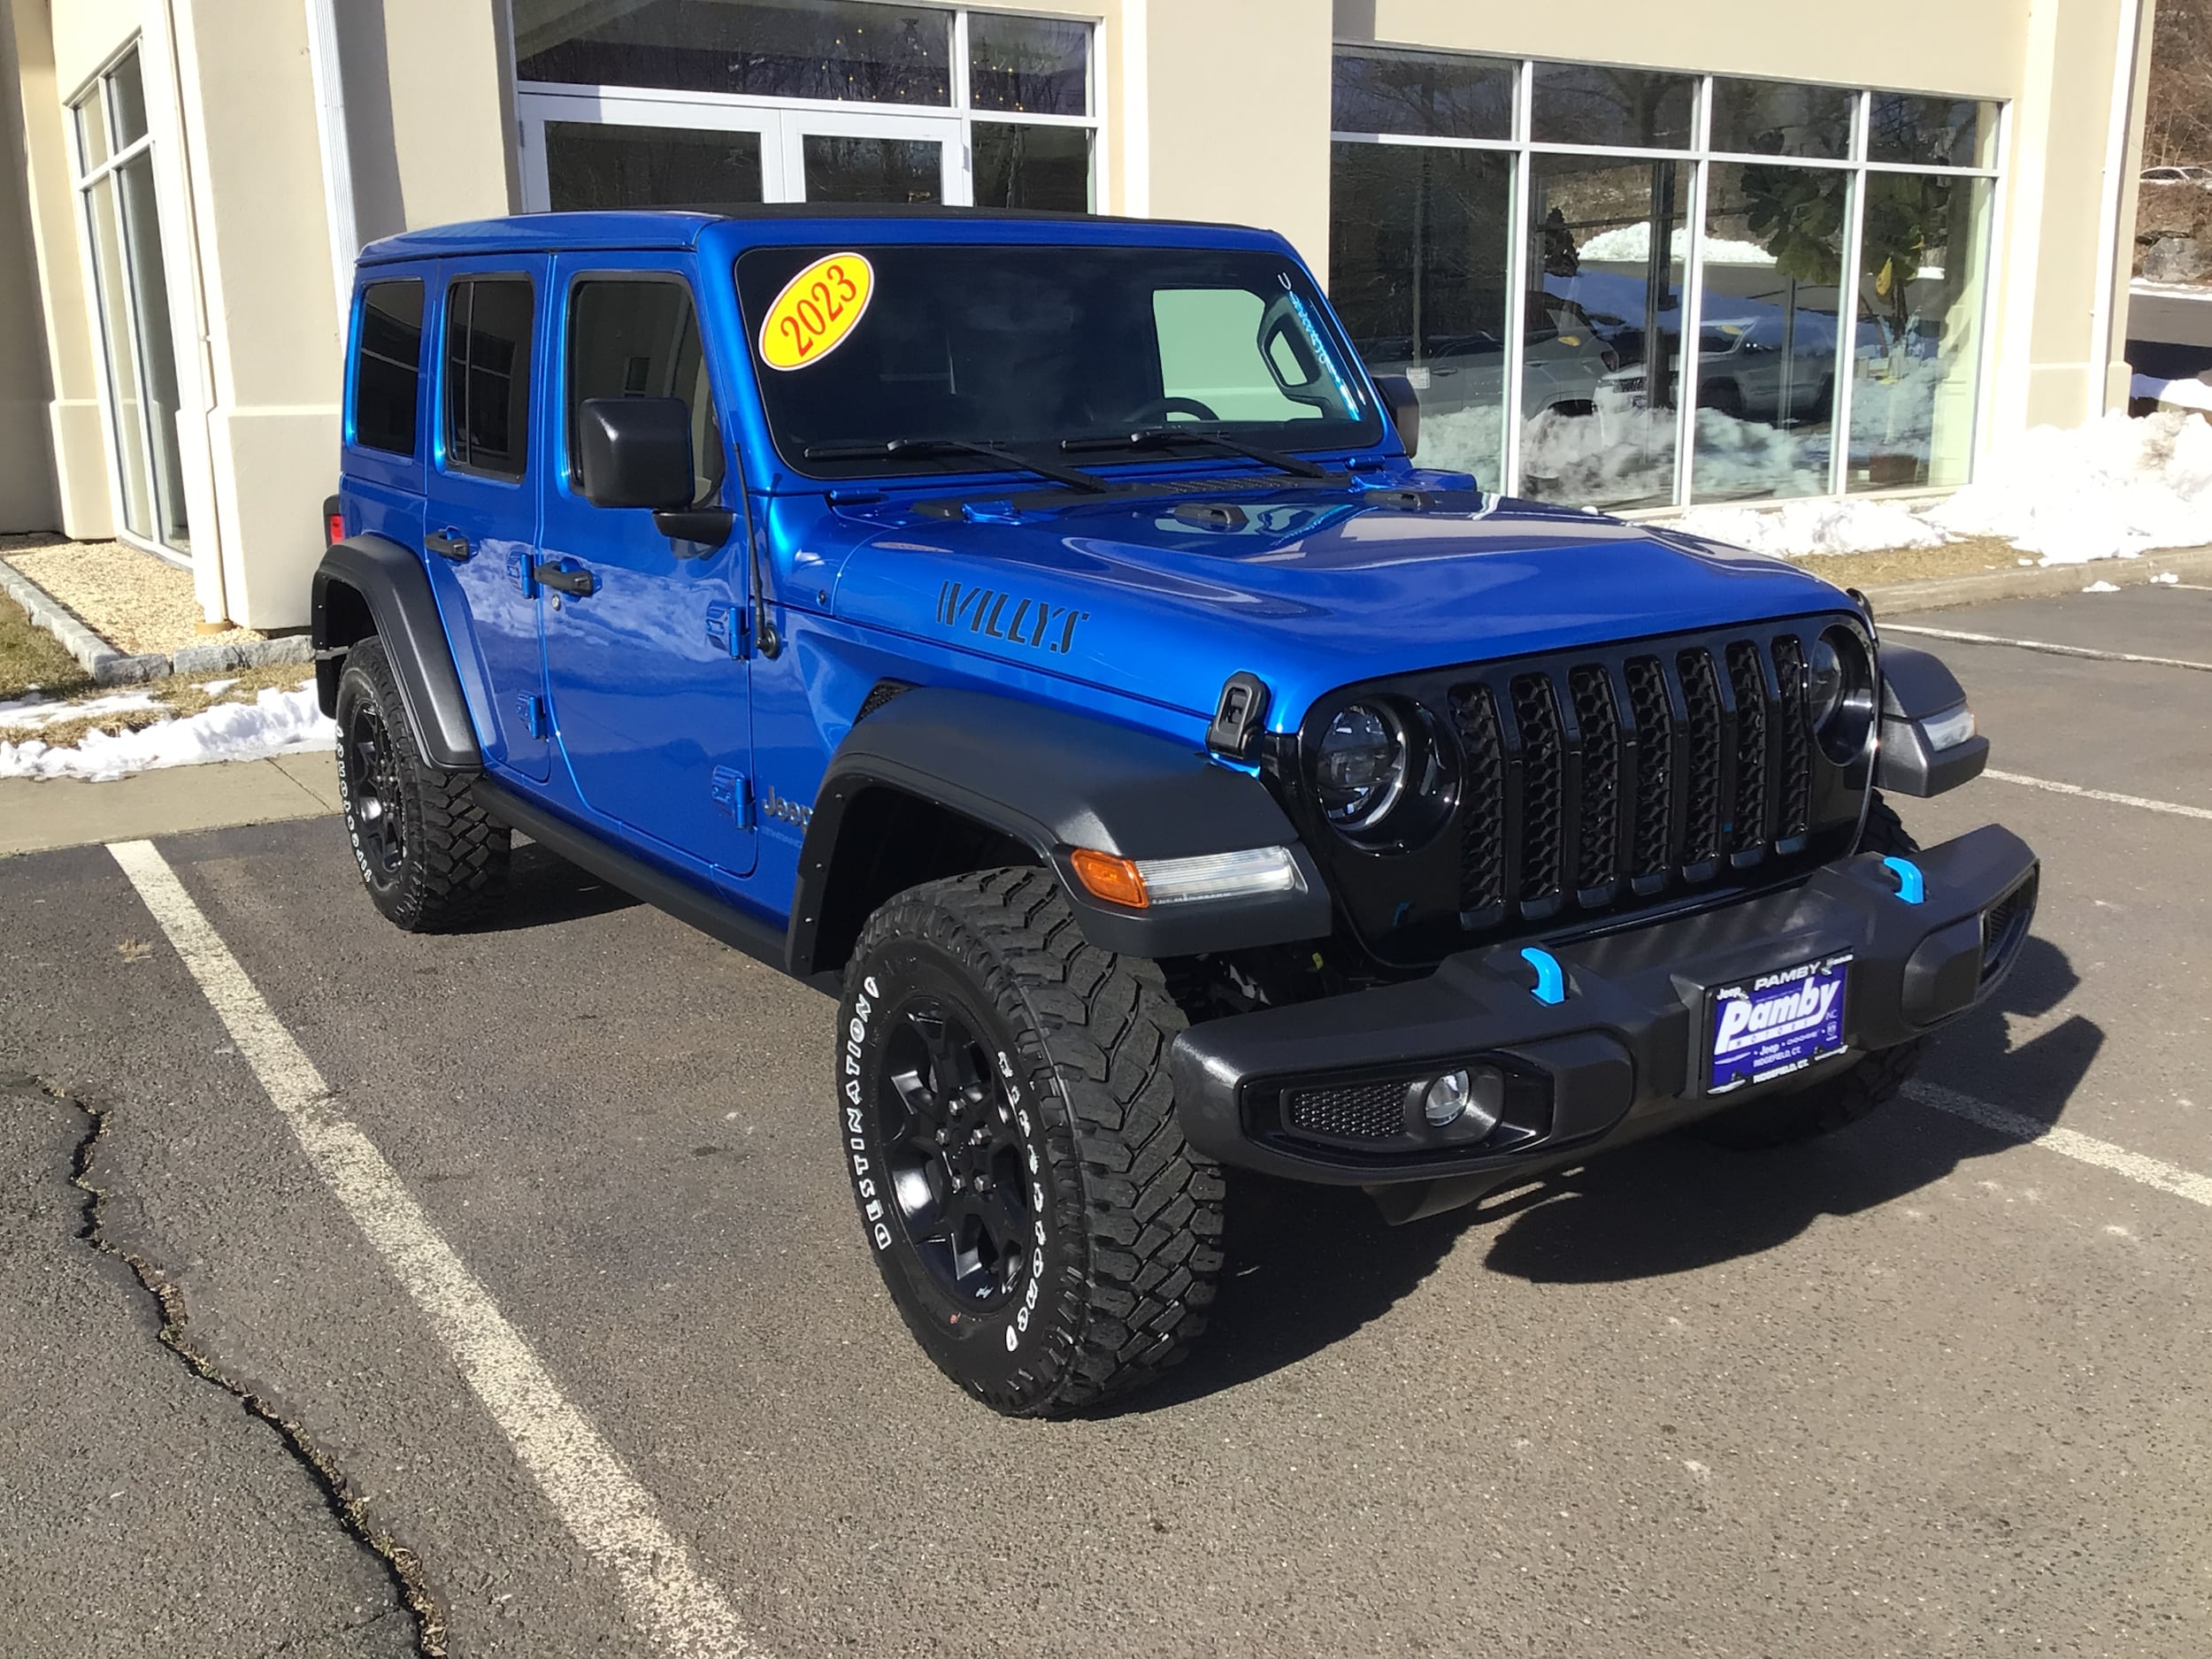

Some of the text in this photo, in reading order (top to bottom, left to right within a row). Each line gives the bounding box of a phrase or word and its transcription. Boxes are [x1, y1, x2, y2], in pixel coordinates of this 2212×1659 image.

[780, 265, 856, 357] 2023
[935, 580, 1090, 655] WILLYS
[762, 785, 814, 835] Jeep
[1754, 961, 1822, 991] PAMBY
[1714, 977, 1841, 1056] Pamby
[1736, 1018, 1809, 1047] MOTORS
[1759, 1043, 1779, 1056] Jeep
[845, 992, 892, 1250] DESTINATION
